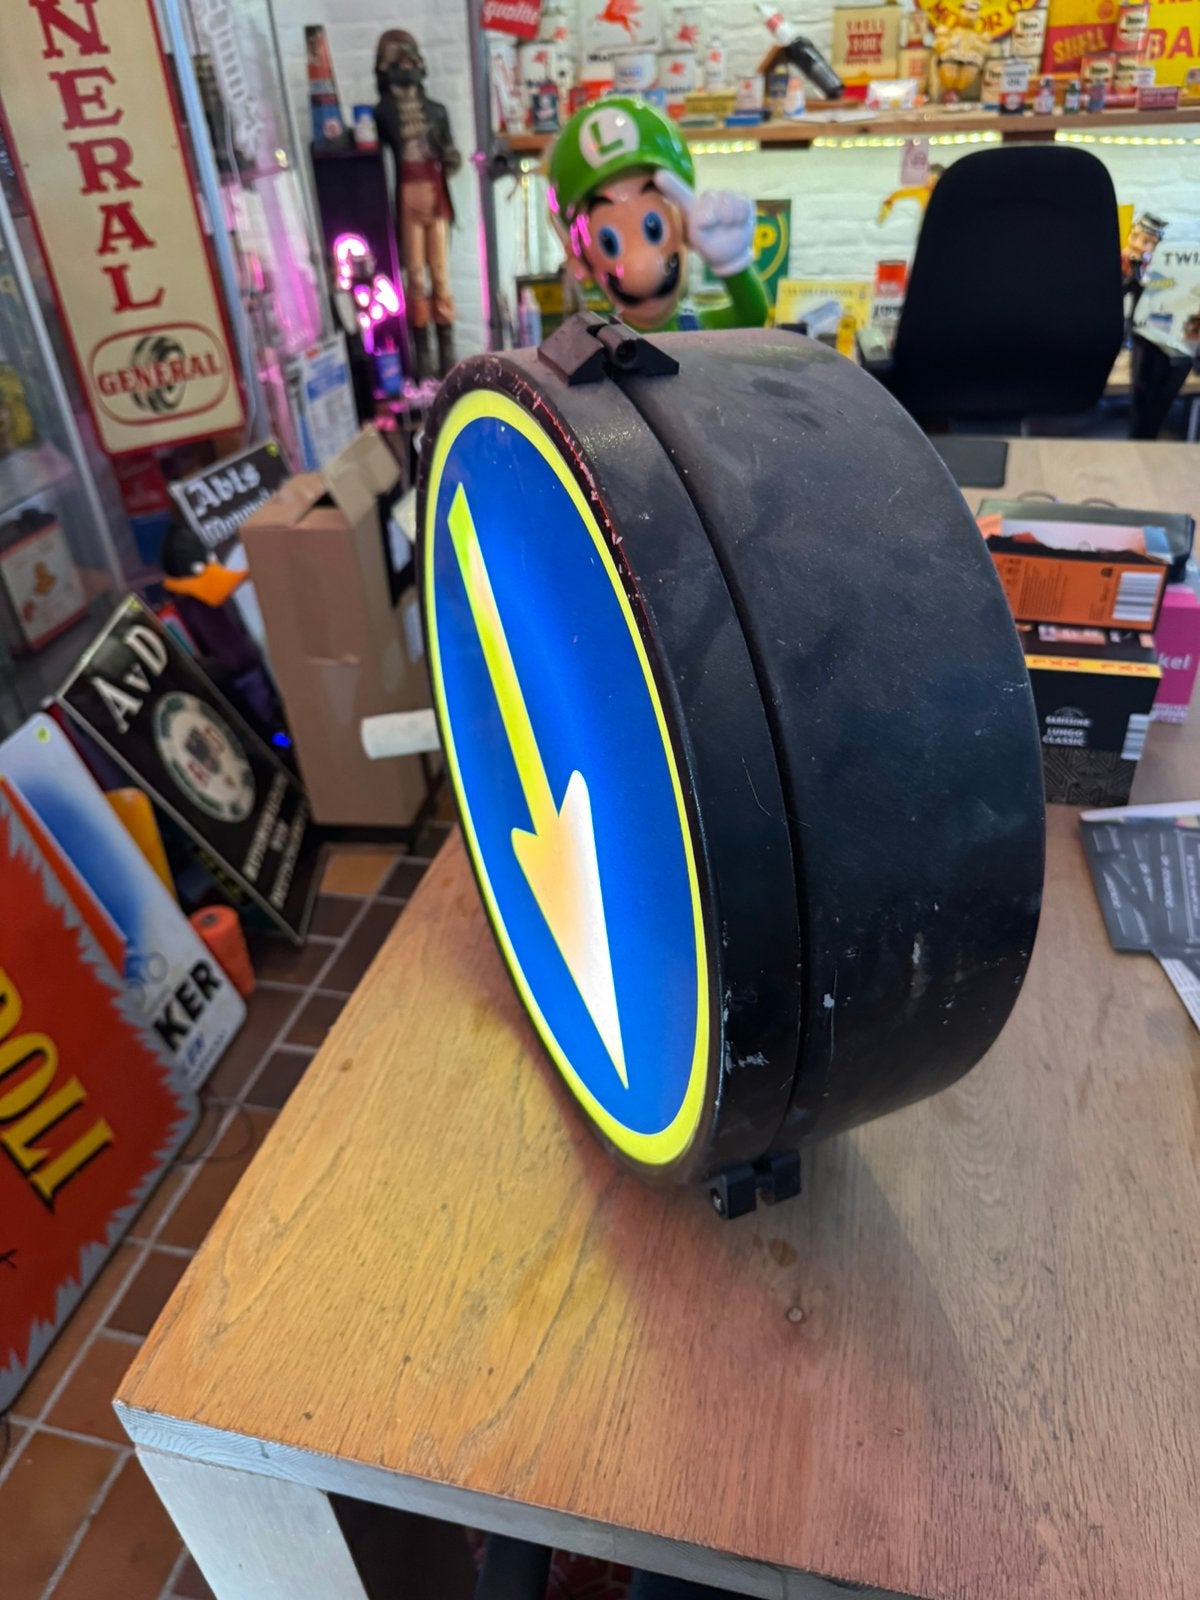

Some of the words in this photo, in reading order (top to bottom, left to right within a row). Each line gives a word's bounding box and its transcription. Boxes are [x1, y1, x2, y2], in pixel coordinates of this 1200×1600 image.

[1052, 27, 1108, 64] SHELL
[1144, 26, 1200, 59] BA
[589, 122, 623, 154] L
[99, 353, 223, 397] GENERAL
[92, 625, 168, 734] AvD
